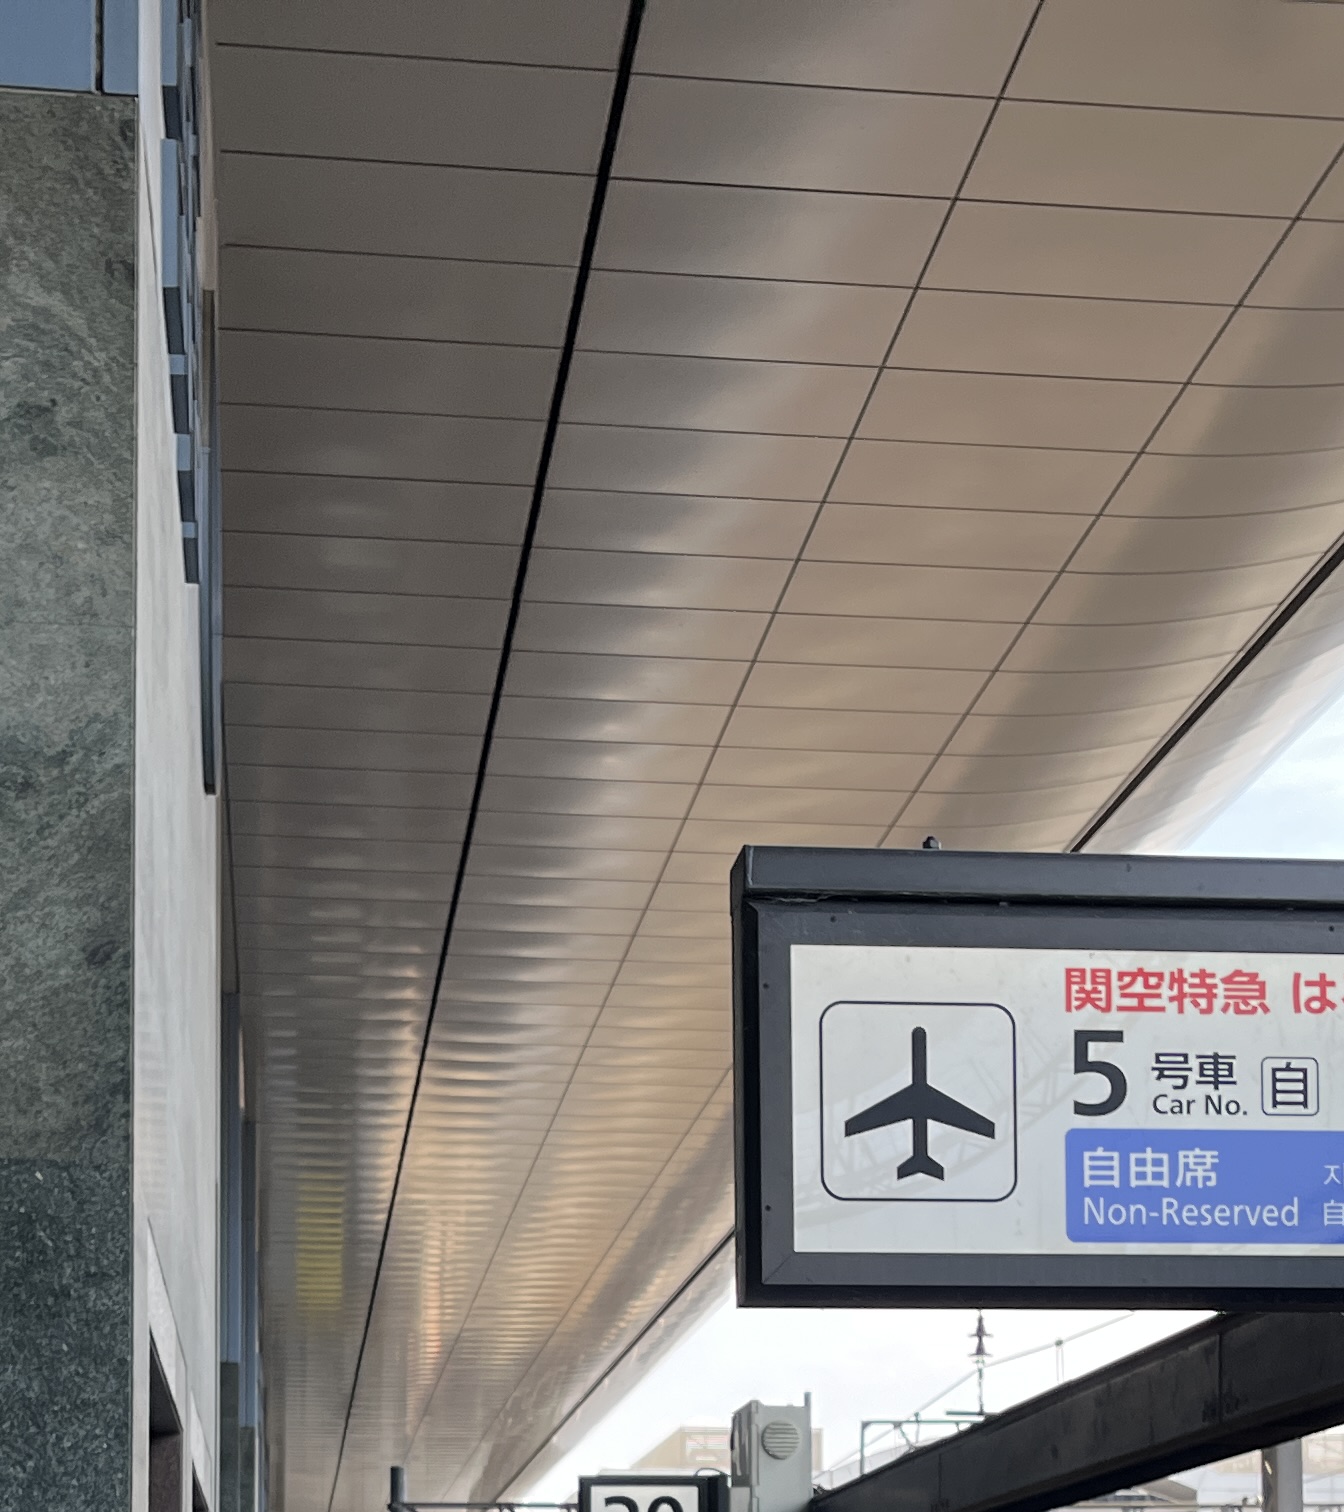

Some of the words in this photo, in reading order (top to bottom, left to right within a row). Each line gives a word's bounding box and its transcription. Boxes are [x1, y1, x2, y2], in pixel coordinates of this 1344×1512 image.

[1064, 967, 1271, 1016] 関空特急
[1072, 1029, 1128, 1117] 5
[1151, 1052, 1238, 1091] 号車
[1271, 1061, 1309, 1110] 自
[1152, 1094, 1196, 1116] Car
[1204, 1094, 1249, 1116] No.
[1082, 1146, 1220, 1189] 自由席
[1082, 1196, 1299, 1227] Non-Reserved
